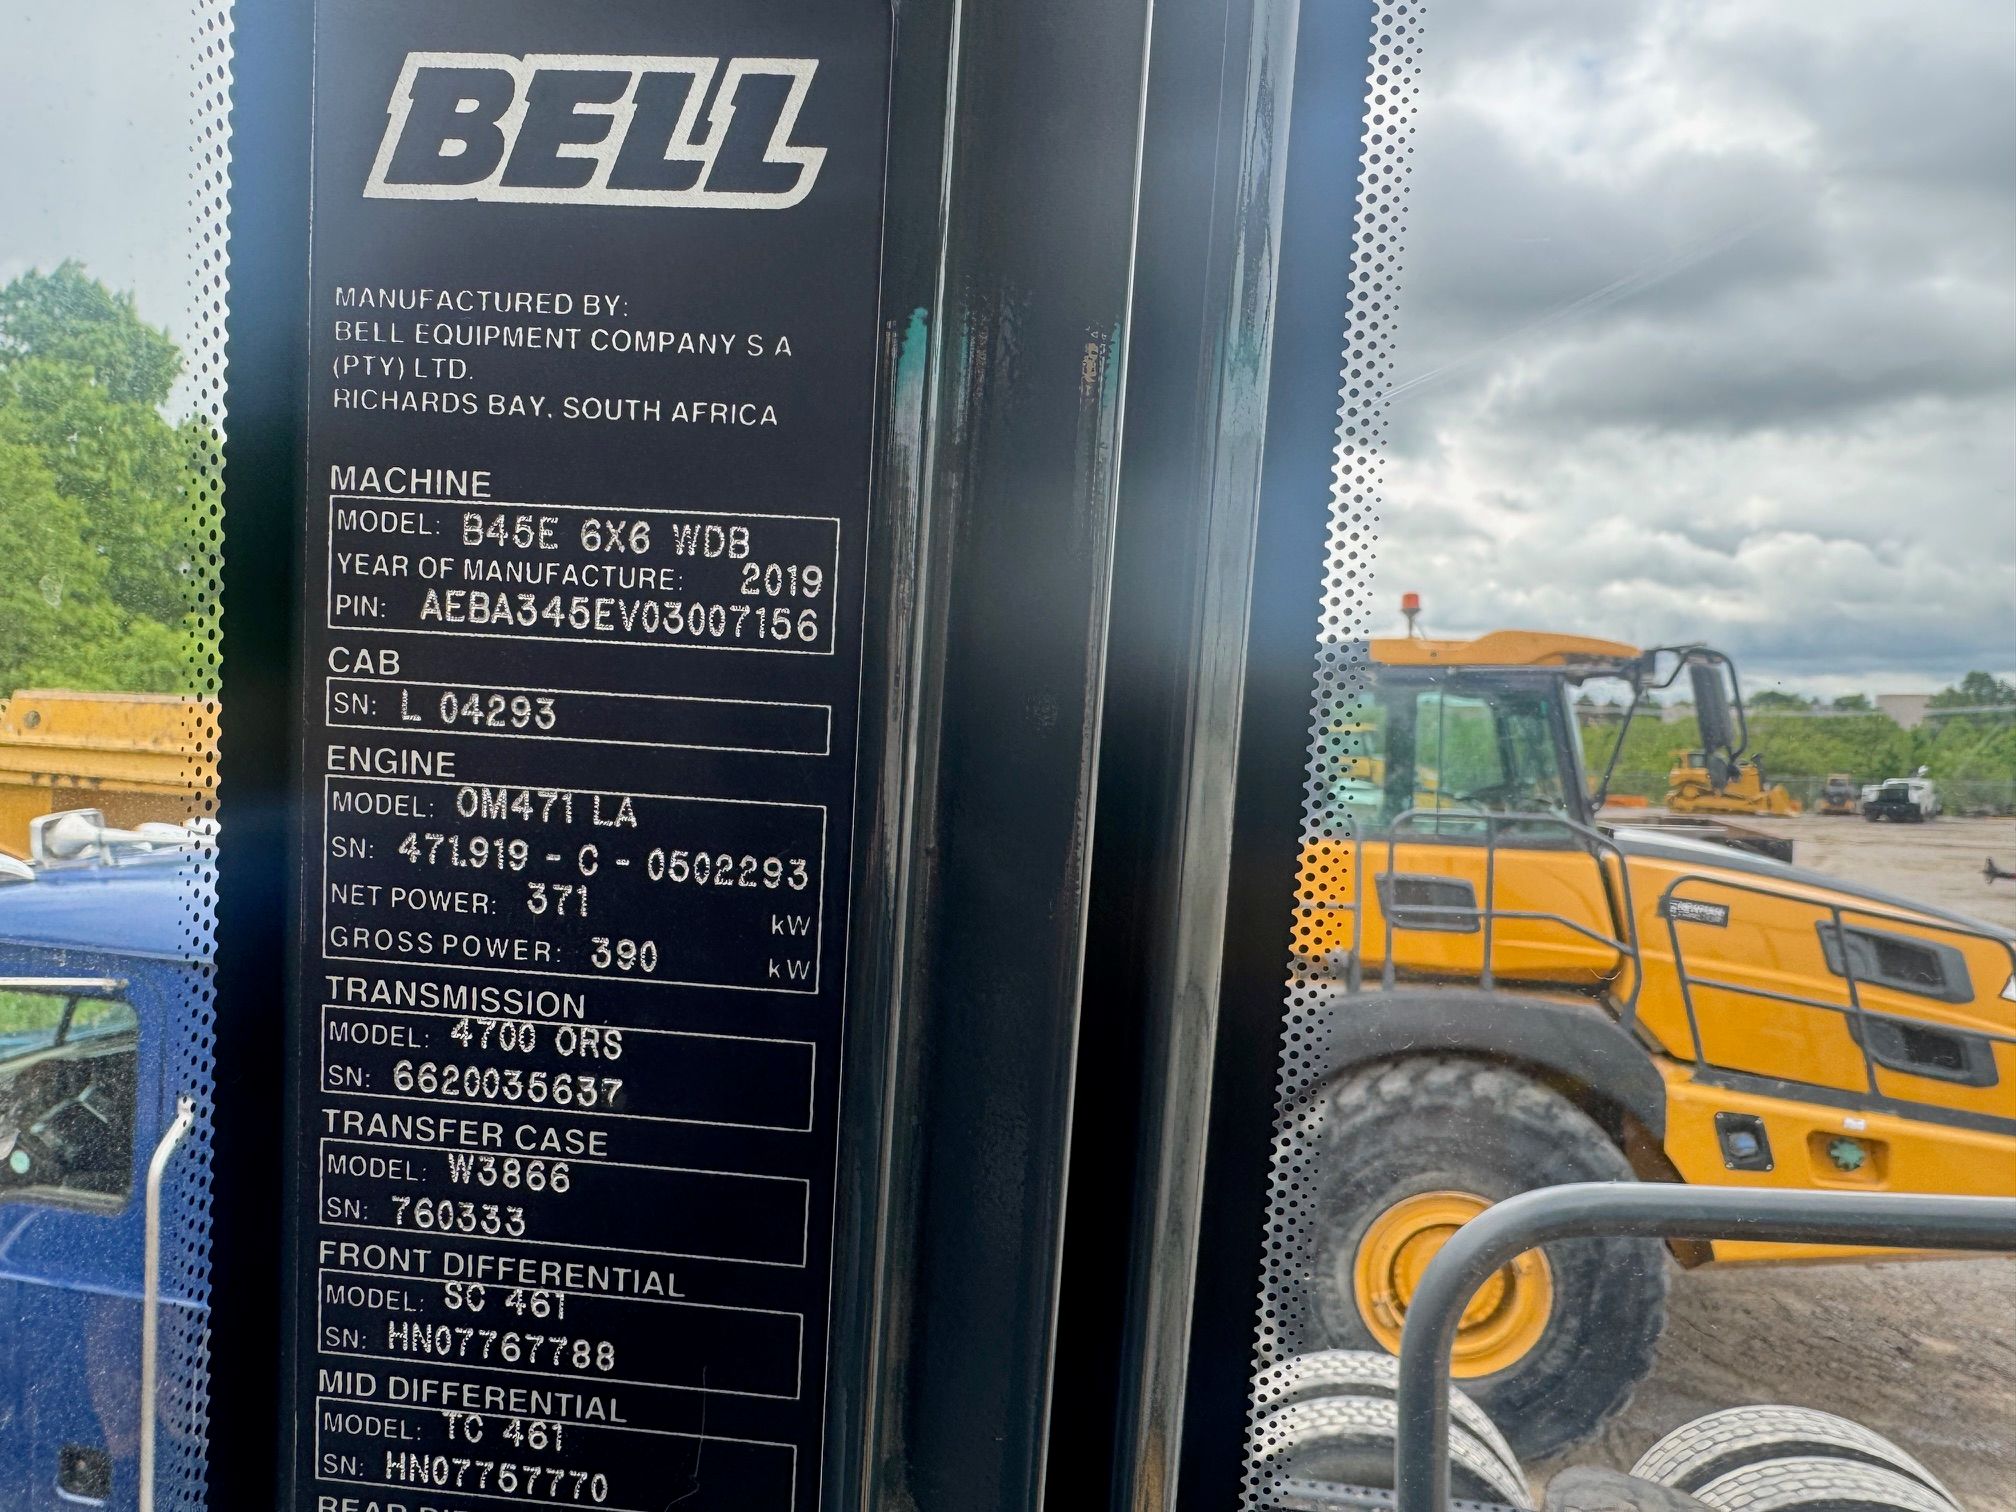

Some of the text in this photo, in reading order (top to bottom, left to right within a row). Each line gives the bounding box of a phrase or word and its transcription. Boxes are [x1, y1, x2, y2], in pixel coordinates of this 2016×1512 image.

[363, 52, 828, 209] BELL
[336, 287, 628, 317] MANUFACTURED BY:
[335, 322, 792, 357] BELL EQUIPMENT COMPANY S A
[333, 355, 473, 381] (PTY) LTD.
[334, 389, 478, 415] RICHARDS
[563, 397, 661, 422] SOUTH
[671, 402, 778, 426] AFRICA
[330, 465, 492, 498] MACHINE
[337, 511, 750, 559] MODEL: B45E 6X6 WDB
[337, 554, 823, 598] YEAR OF MANUFACTURE: 2019
[336, 589, 818, 642] PIN: AEBA345EV03007156
[328, 648, 400, 676] CAB
[334, 688, 556, 730] SN: L 04293
[328, 745, 456, 778] ENGINE
[333, 793, 434, 819] MODEL:
[593, 794, 638, 828] LA
[332, 837, 374, 859] SN:
[578, 843, 599, 876] C
[647, 847, 808, 891] 0502293
[331, 882, 588, 917] NET POWER: 371
[772, 915, 810, 936] kW
[330, 926, 658, 973] GROSS POWER: 390
[769, 960, 810, 980] kW
[326, 975, 585, 1019] TRANSMISSION
[330, 1023, 428, 1049] MODEL:
[450, 1019, 535, 1053] 4700
[329, 1060, 623, 1107] SN: 6620035637
[323, 1110, 608, 1157] TRANSFER CASE
[328, 1153, 570, 1192] MODEL: W3866
[327, 1196, 526, 1237] SN: 760333
[320, 1242, 685, 1298] FRONT DIFFERENTIAL
[326, 1282, 566, 1320] MODEL: SC 461
[326, 1320, 614, 1372] SN: HN07767788
[319, 1370, 627, 1424] MID DIFFERENTIAL
[324, 1411, 563, 1453] MODEL: TC 461
[323, 1454, 364, 1477] SN:
